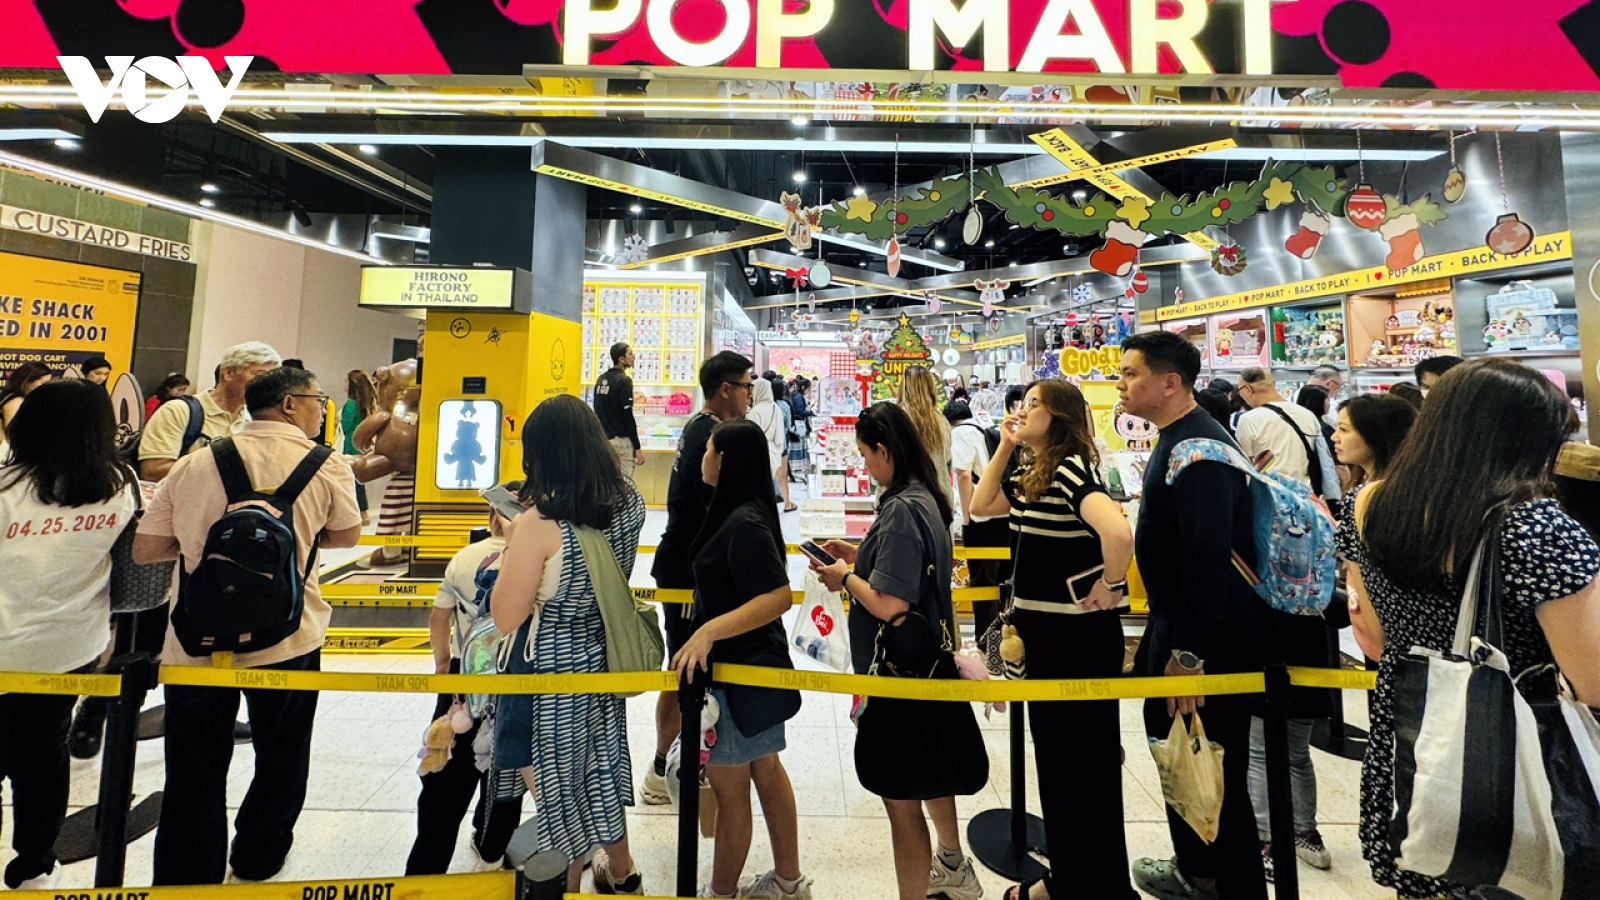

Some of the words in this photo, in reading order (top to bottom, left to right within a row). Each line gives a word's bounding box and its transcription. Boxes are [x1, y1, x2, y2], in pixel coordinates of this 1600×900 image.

[563, 0, 835, 68] POP
[908, 0, 1273, 75] MART
[1031, 175, 1070, 186] MART
[1092, 161, 1136, 174] BACK
[1140, 155, 1161, 165] TO
[1164, 145, 1210, 160] PLAY
[14, 210, 130, 249] CUSTARD
[138, 235, 192, 262] FRIES
[408, 283, 473, 292] FACTORY
[414, 272, 469, 282] HIRONO
[1194, 303, 1208, 312] BACK
[1208, 302, 1215, 310] TO
[1214, 300, 1230, 309] PLAY
[1251, 293, 1266, 302] POP
[1265, 289, 1285, 299] MART
[1294, 283, 1316, 295] BACK
[1316, 281, 1328, 291] TO
[1328, 278, 1351, 290] PLAY
[1411, 261, 1443, 275] MART
[1462, 252, 1498, 267] BACK
[400, 293, 412, 302] IN
[418, 293, 478, 303] THAILAND
[31, 299, 95, 320] SHACK
[30, 321, 52, 338] IN
[60, 324, 107, 342] 2001
[1061, 347, 1111, 375] Good
[5, 512, 117, 539] 04.25.2024
[379, 586, 395, 594] POP
[396, 585, 418, 594] MART
[634, 589, 656, 600] MART
[302, 886, 339, 900] POP
[343, 883, 396, 900] MART
